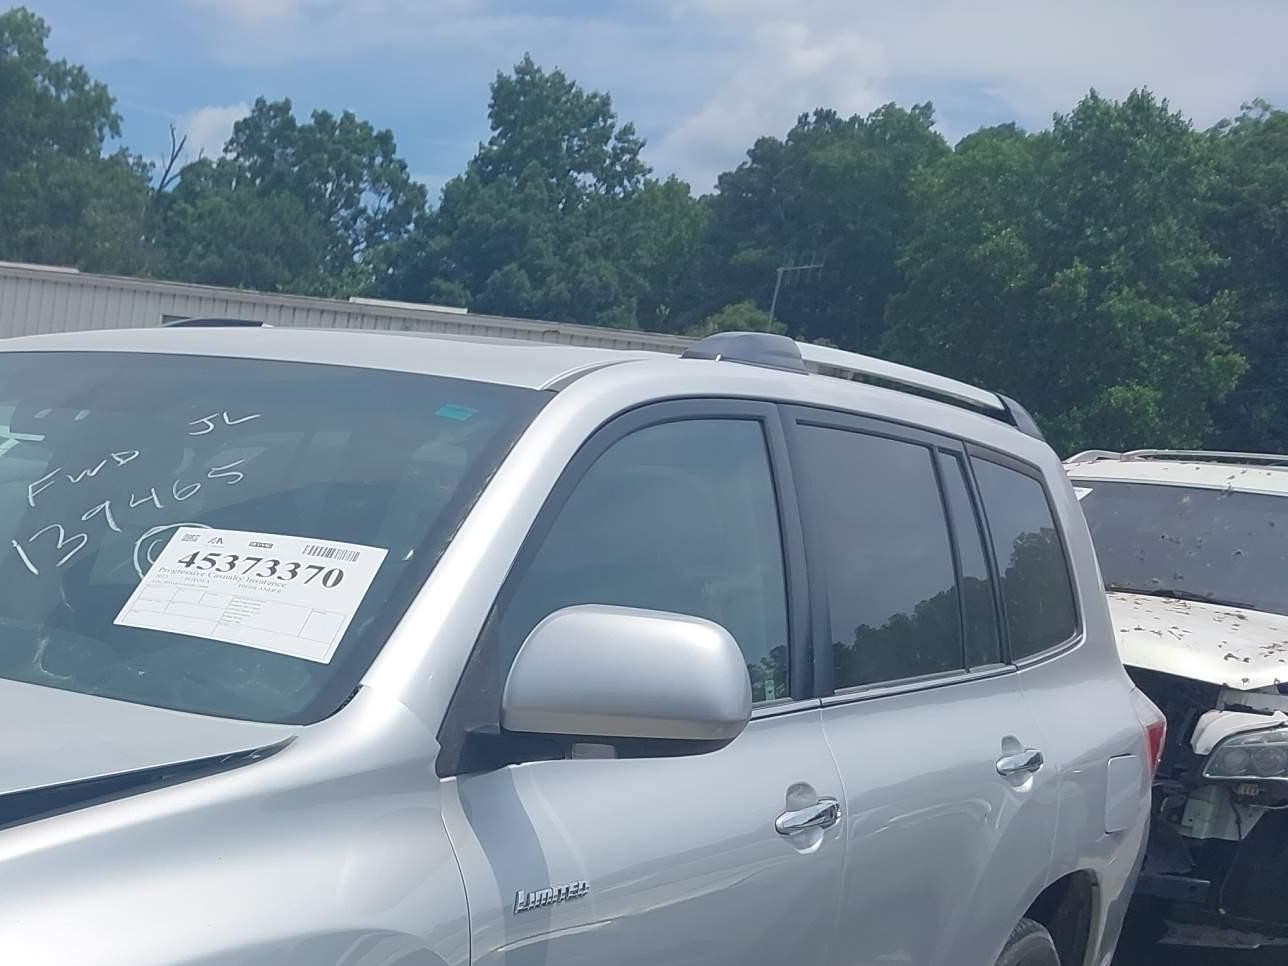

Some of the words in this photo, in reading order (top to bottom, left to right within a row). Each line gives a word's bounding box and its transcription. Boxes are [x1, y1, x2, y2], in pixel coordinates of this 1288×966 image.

[27, 449, 141, 508] FWD
[176, 550, 345, 589] 45373370
[246, 576, 287, 588] Insurance
